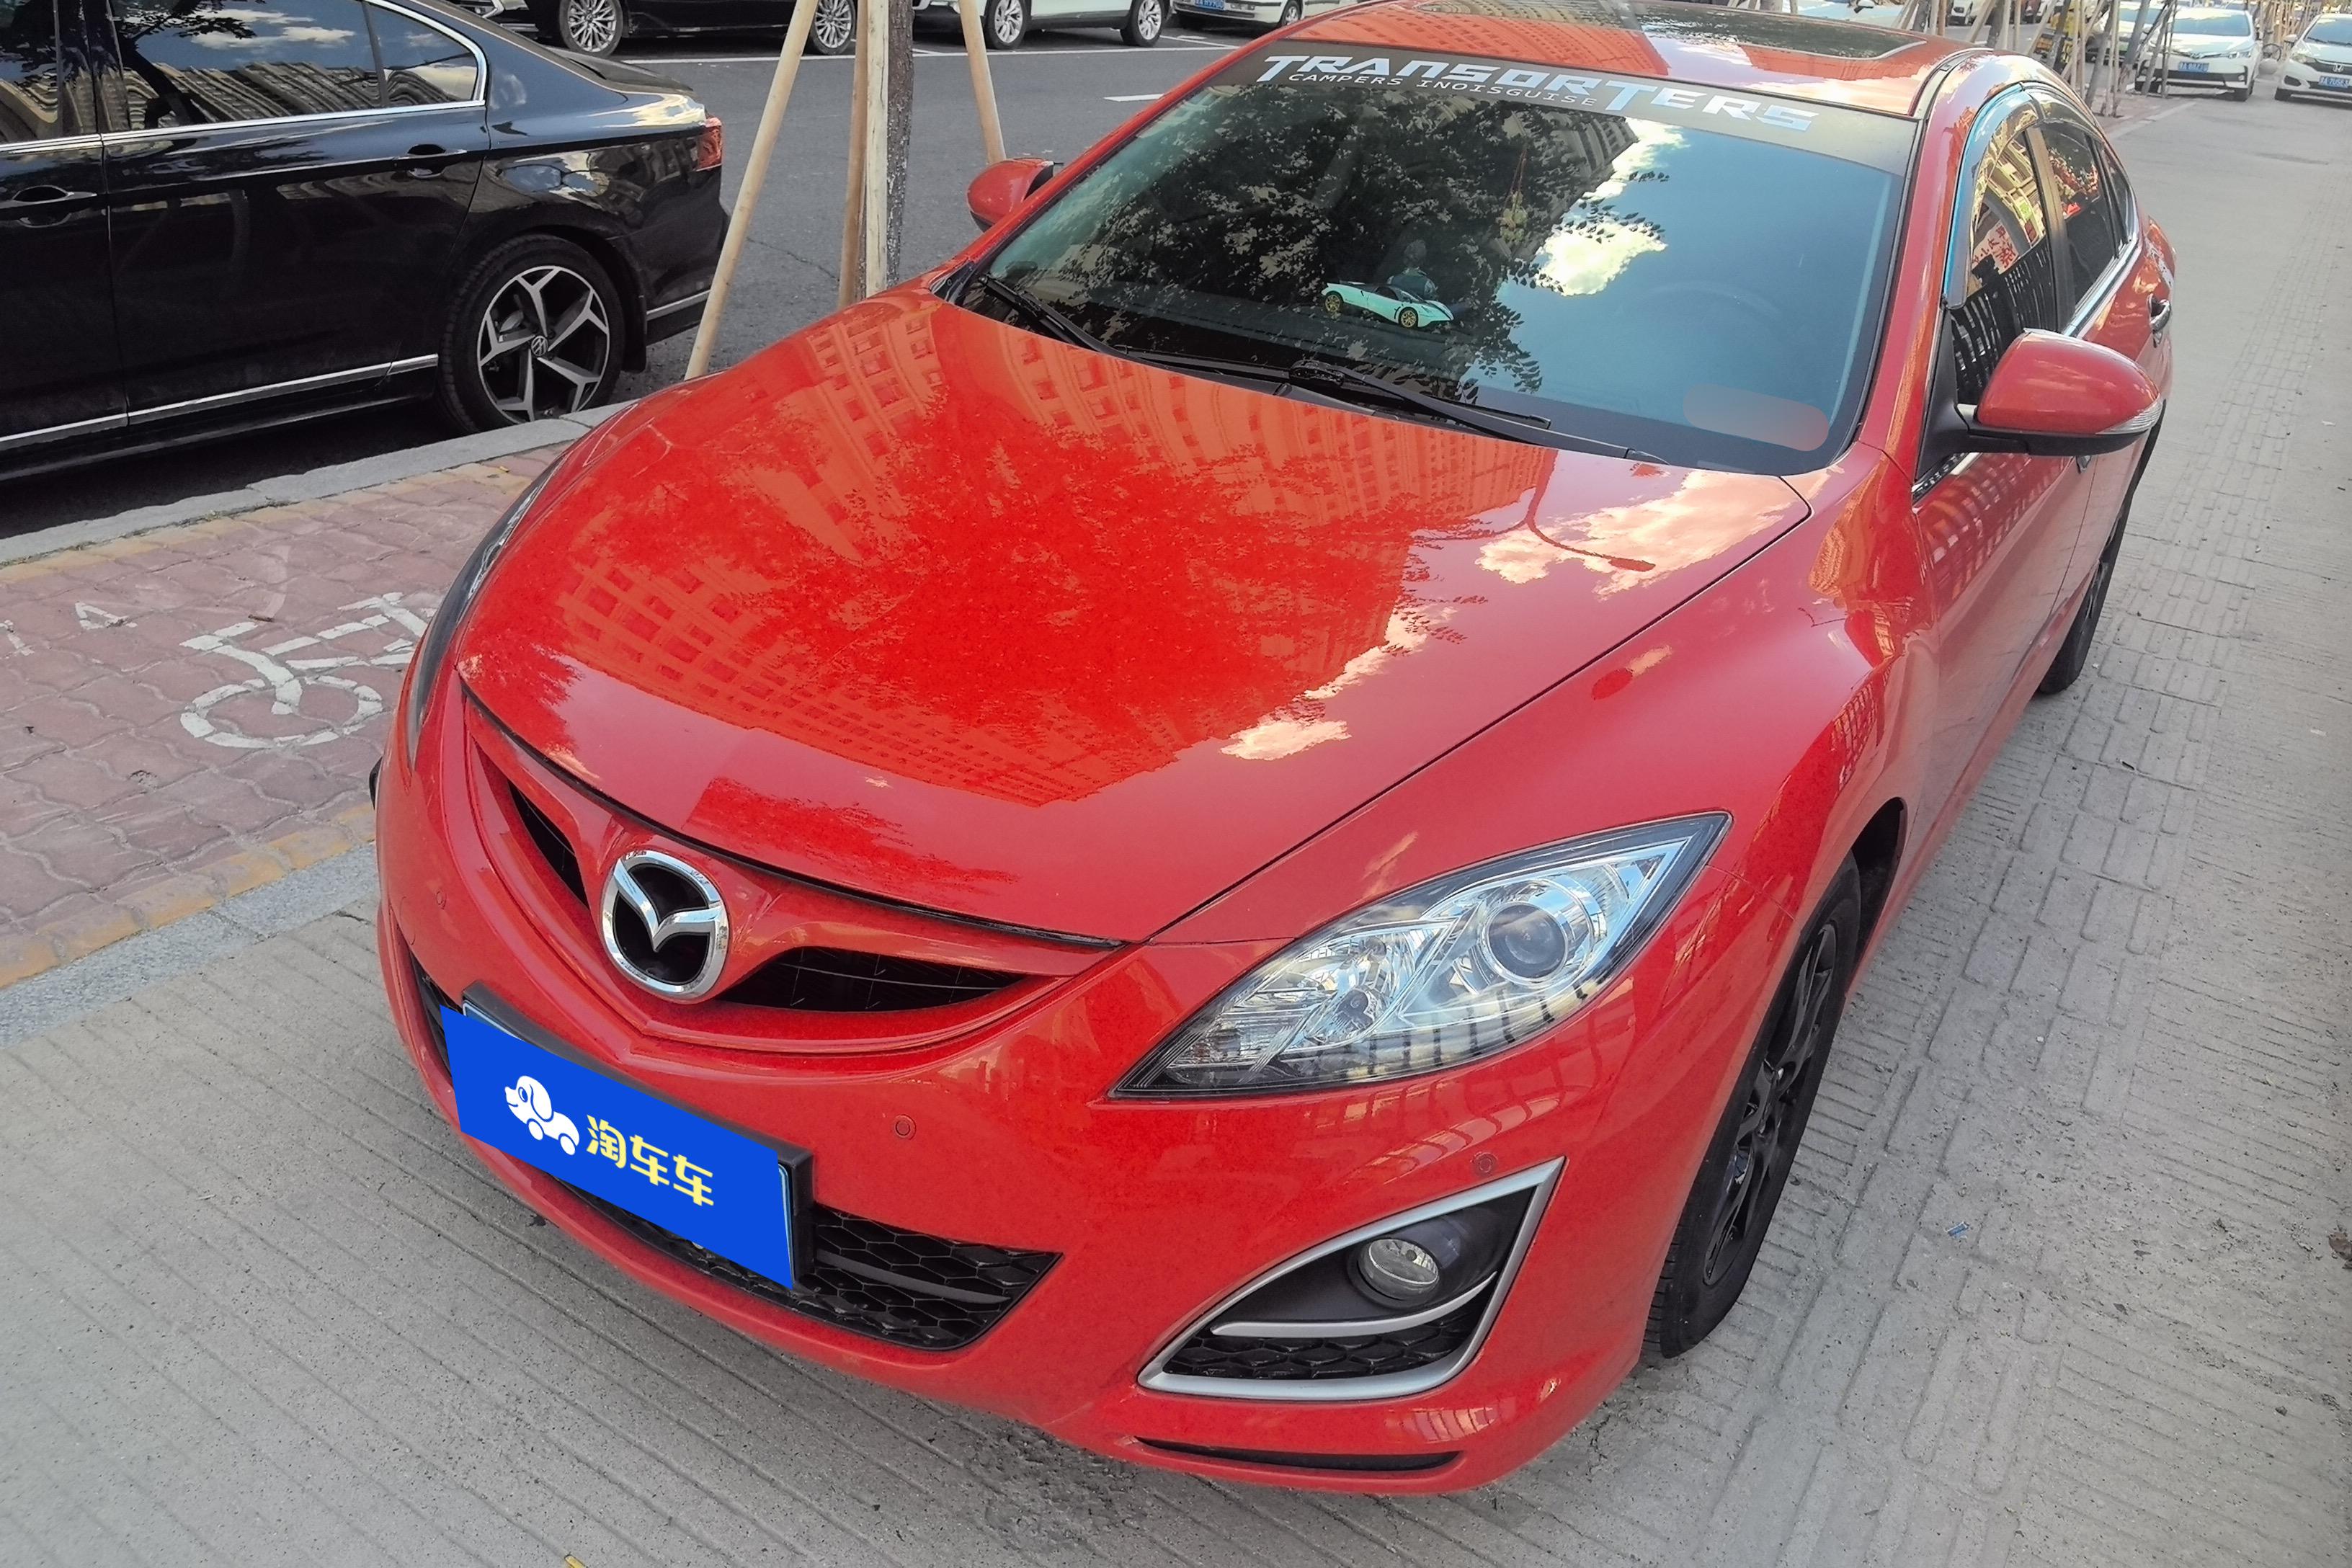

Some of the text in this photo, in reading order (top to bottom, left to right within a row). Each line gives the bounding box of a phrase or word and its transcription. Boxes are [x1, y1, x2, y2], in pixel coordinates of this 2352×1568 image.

[1256, 55, 1819, 131] TRANSORTERS
[1288, 74, 1598, 107] CAMPERS INOISGUISE
